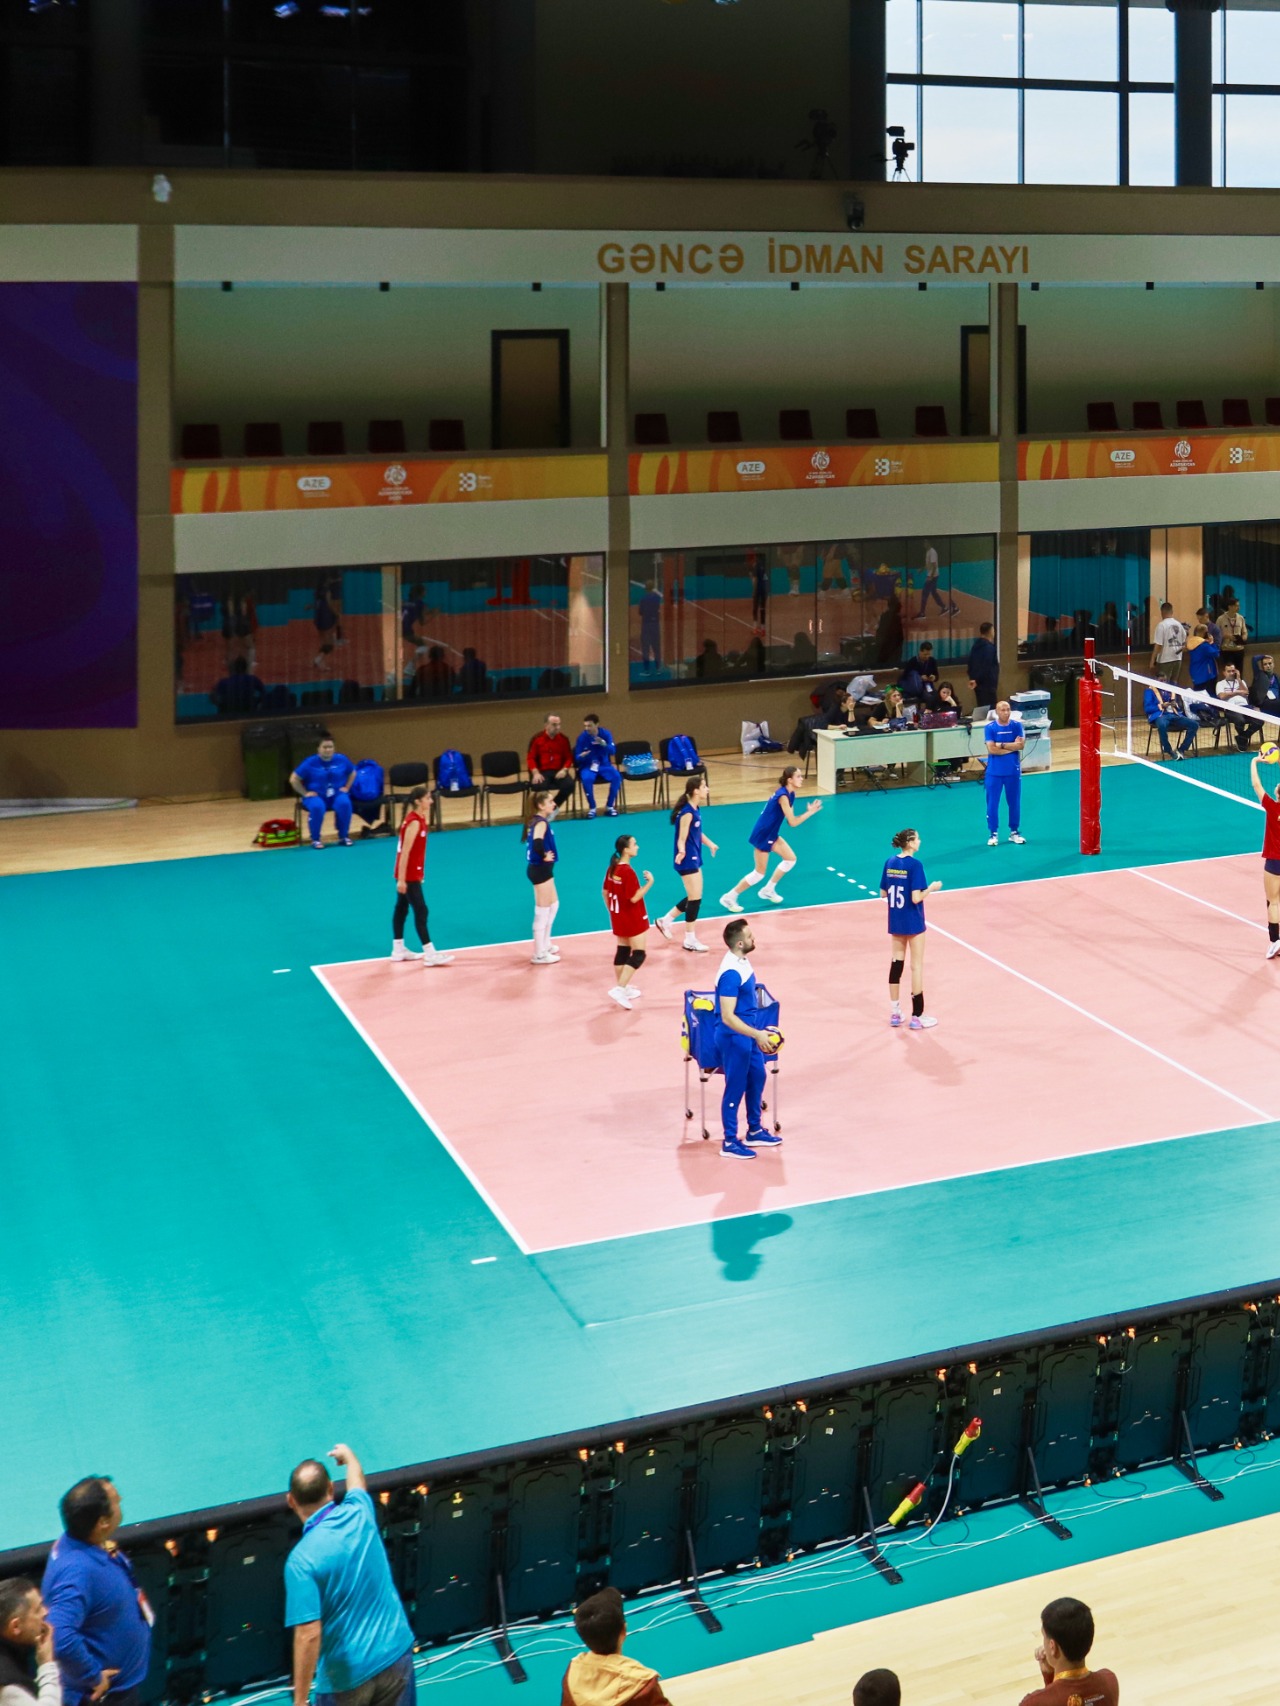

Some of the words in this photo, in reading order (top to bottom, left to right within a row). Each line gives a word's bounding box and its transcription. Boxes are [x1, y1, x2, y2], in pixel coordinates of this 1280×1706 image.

[597, 242, 745, 275] GƏNCƏ
[768, 237, 883, 274] İDMAN
[903, 244, 1029, 275] SARAYI
[1114, 452, 1131, 460] AZE
[741, 463, 761, 472] AZE
[303, 478, 326, 488] AZE
[888, 885, 905, 909] 15
